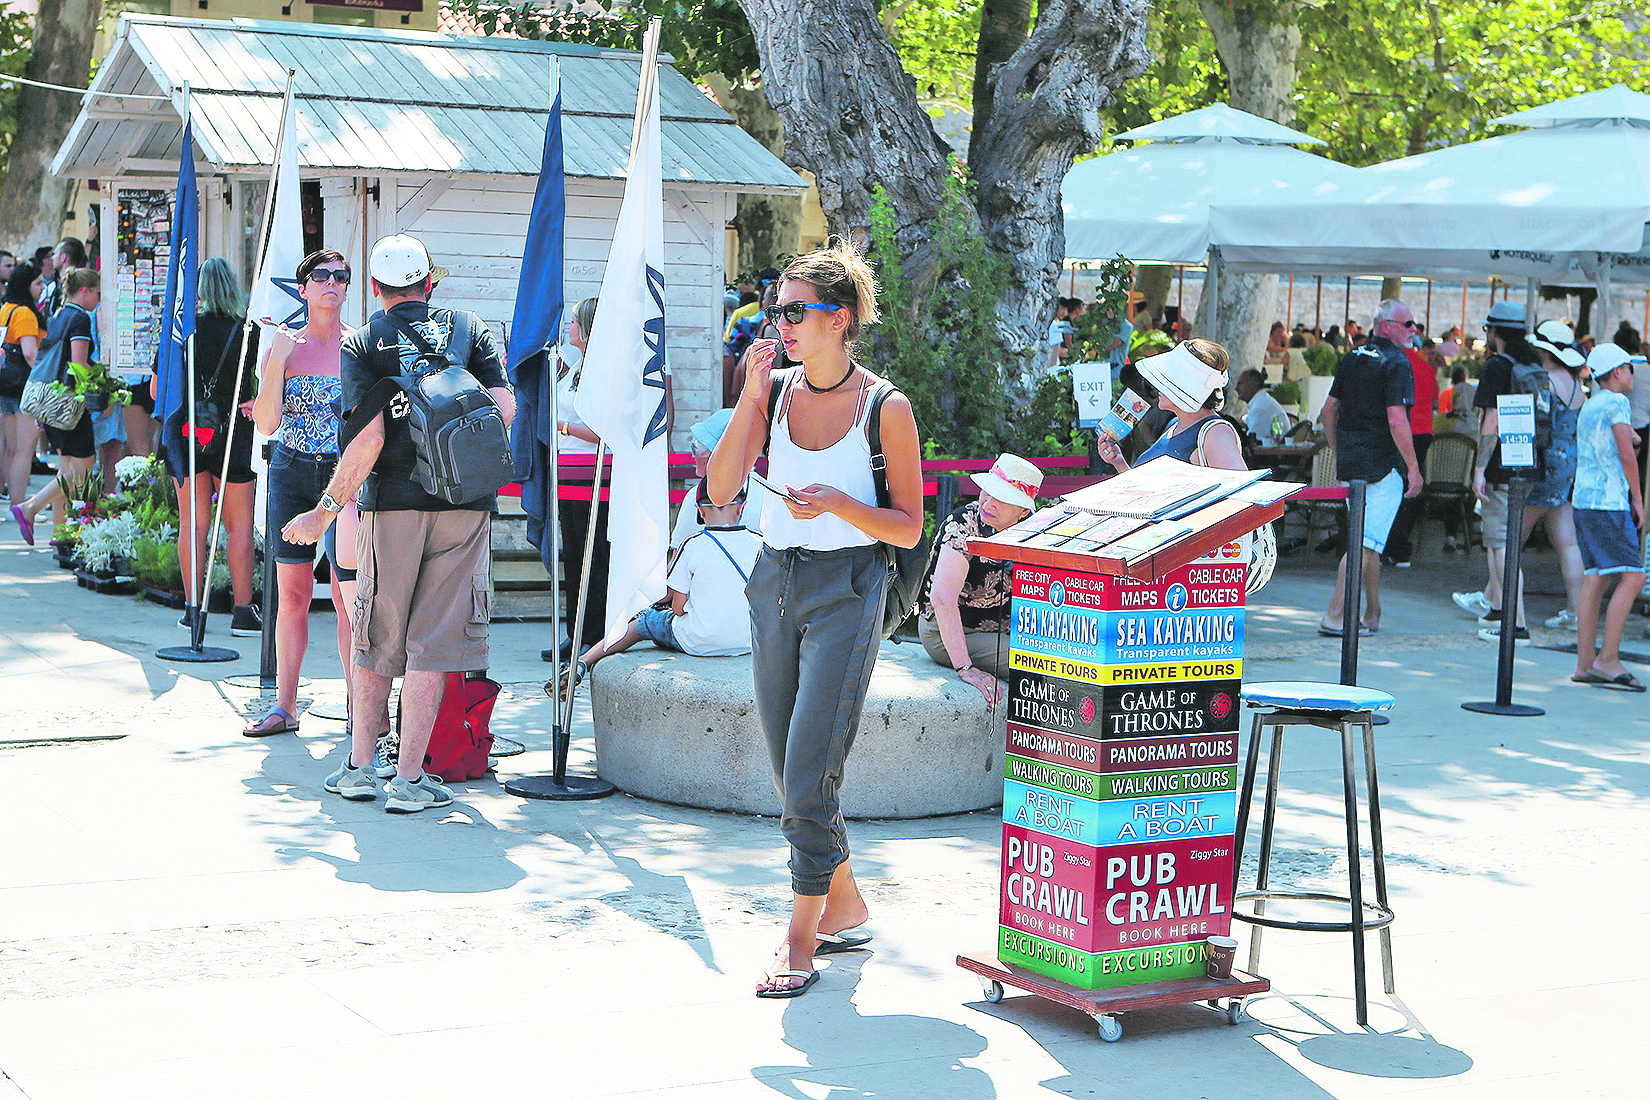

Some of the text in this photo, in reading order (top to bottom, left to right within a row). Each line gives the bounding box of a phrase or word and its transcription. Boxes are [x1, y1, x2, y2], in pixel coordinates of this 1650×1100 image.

[1080, 381, 1105, 392] EXIT
[1015, 569, 1052, 584] FREE CITY
[1064, 576, 1105, 592] CABLE CAR
[1188, 568, 1244, 585] CABLE CAR
[1020, 583, 1045, 597] MAPS
[1066, 590, 1101, 606] TICKETS
[1121, 590, 1158, 606] MAPS
[1192, 588, 1239, 604] TICKETS
[1017, 605, 1099, 646] SEA KAYAKING
[1116, 614, 1235, 647] SEA KAYAKING
[1017, 634, 1097, 658] Transparent kayaks
[1115, 644, 1234, 660] Transparent kayaks
[1014, 654, 1098, 680] PRIVATE TOURS
[1112, 664, 1235, 681] PRIVATE TOURS
[1019, 678, 1070, 703] GAME OF
[1120, 689, 1197, 711] GAME OF
[1012, 697, 1075, 729] THRONES
[1110, 709, 1204, 734] THRONES
[1012, 729, 1097, 764] PANORAMA TOURS
[1110, 740, 1234, 764] PANORAMA TOURS
[1012, 759, 1093, 794] WALKING TOURS
[1111, 770, 1229, 795] WALKING TOURS
[1026, 789, 1075, 816] RENT
[1133, 798, 1205, 820] RENT
[1015, 805, 1085, 837] A BOAT
[1117, 815, 1220, 840] A BOAT
[1007, 836, 1055, 879] PUB
[1063, 850, 1079, 866] Ziggy
[1190, 847, 1229, 861] Ziggy Star
[1106, 852, 1177, 890] PUB
[1006, 872, 1090, 926] CRAWL
[1105, 883, 1226, 926] CRAWL
[1015, 911, 1076, 941] BOOK HERE
[1119, 921, 1207, 944] BOOK HERE
[1003, 930, 1086, 974] EXCURSIONS
[1102, 943, 1208, 975] EXCURSION
